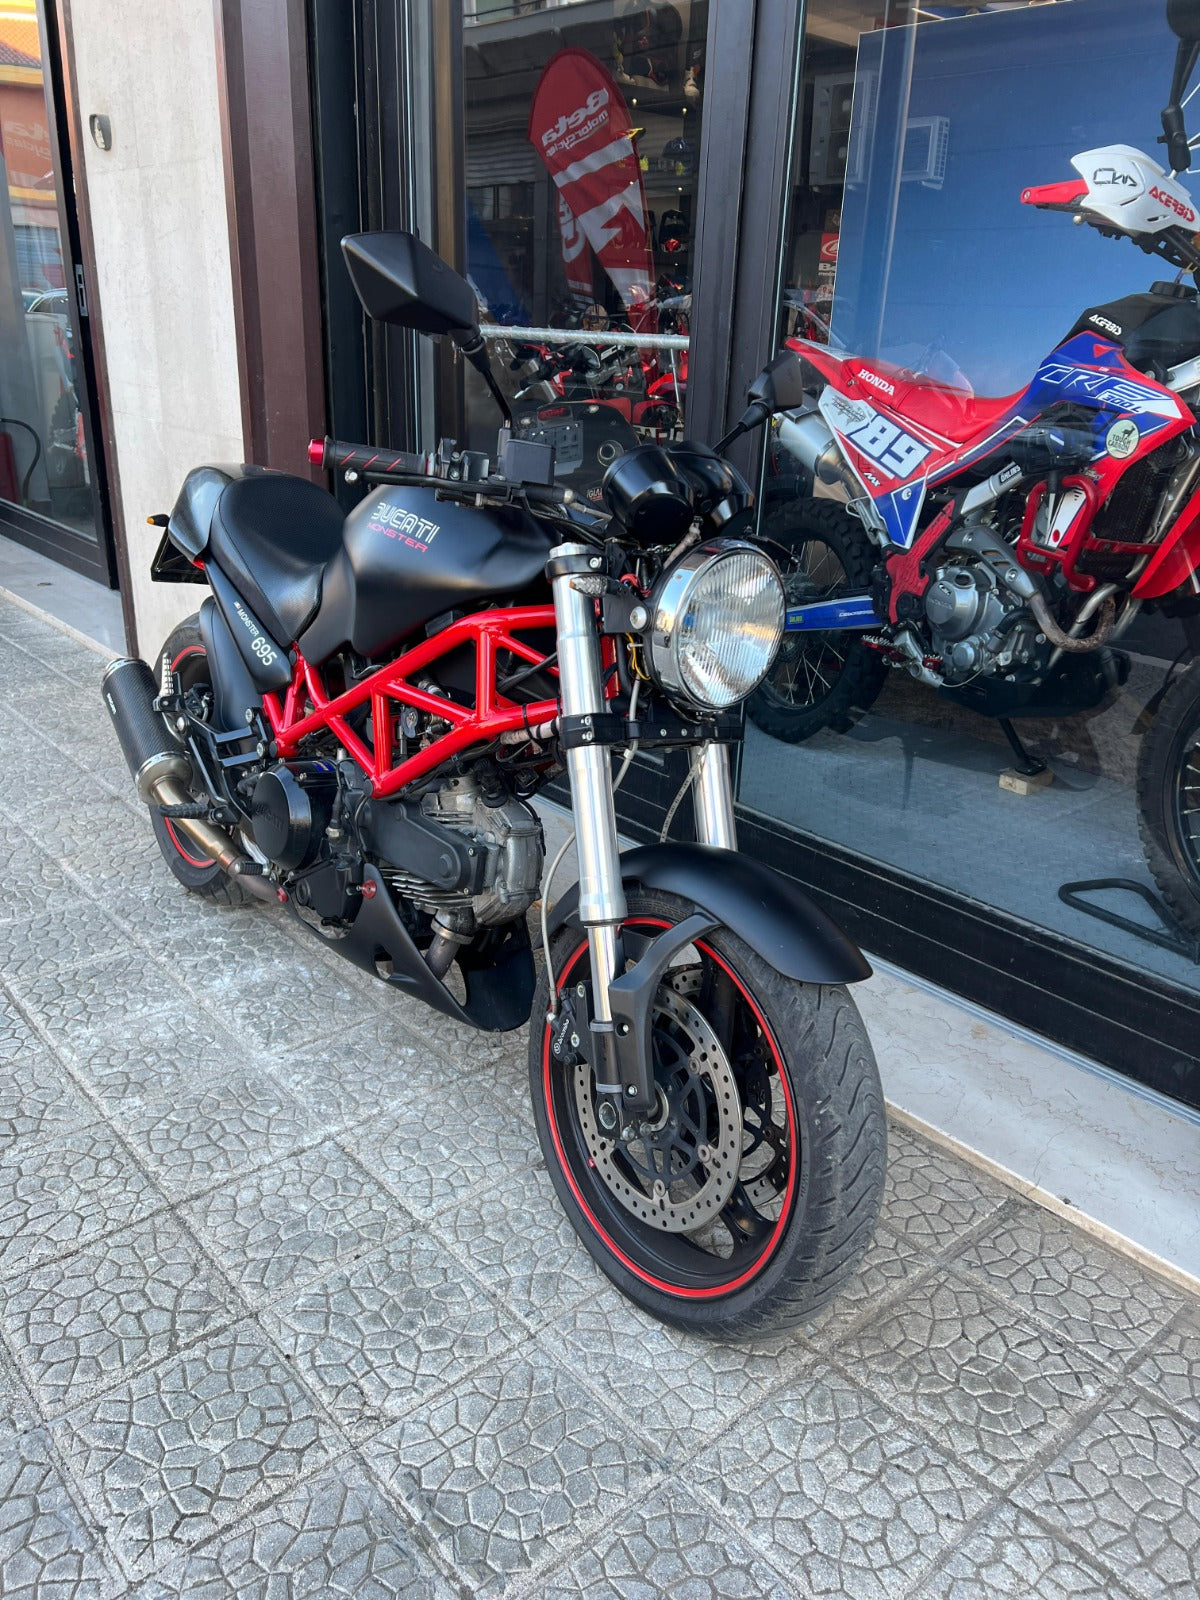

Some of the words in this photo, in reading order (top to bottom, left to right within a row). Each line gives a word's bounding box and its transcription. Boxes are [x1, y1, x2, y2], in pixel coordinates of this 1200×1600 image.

[1089, 314, 1122, 336] ACERBIS
[858, 368, 895, 396] HONDA
[367, 522, 429, 553] MONSTER
[371, 502, 440, 544] DUCATI
[237, 608, 260, 637] MONSTER
[251, 636, 278, 666] 695
